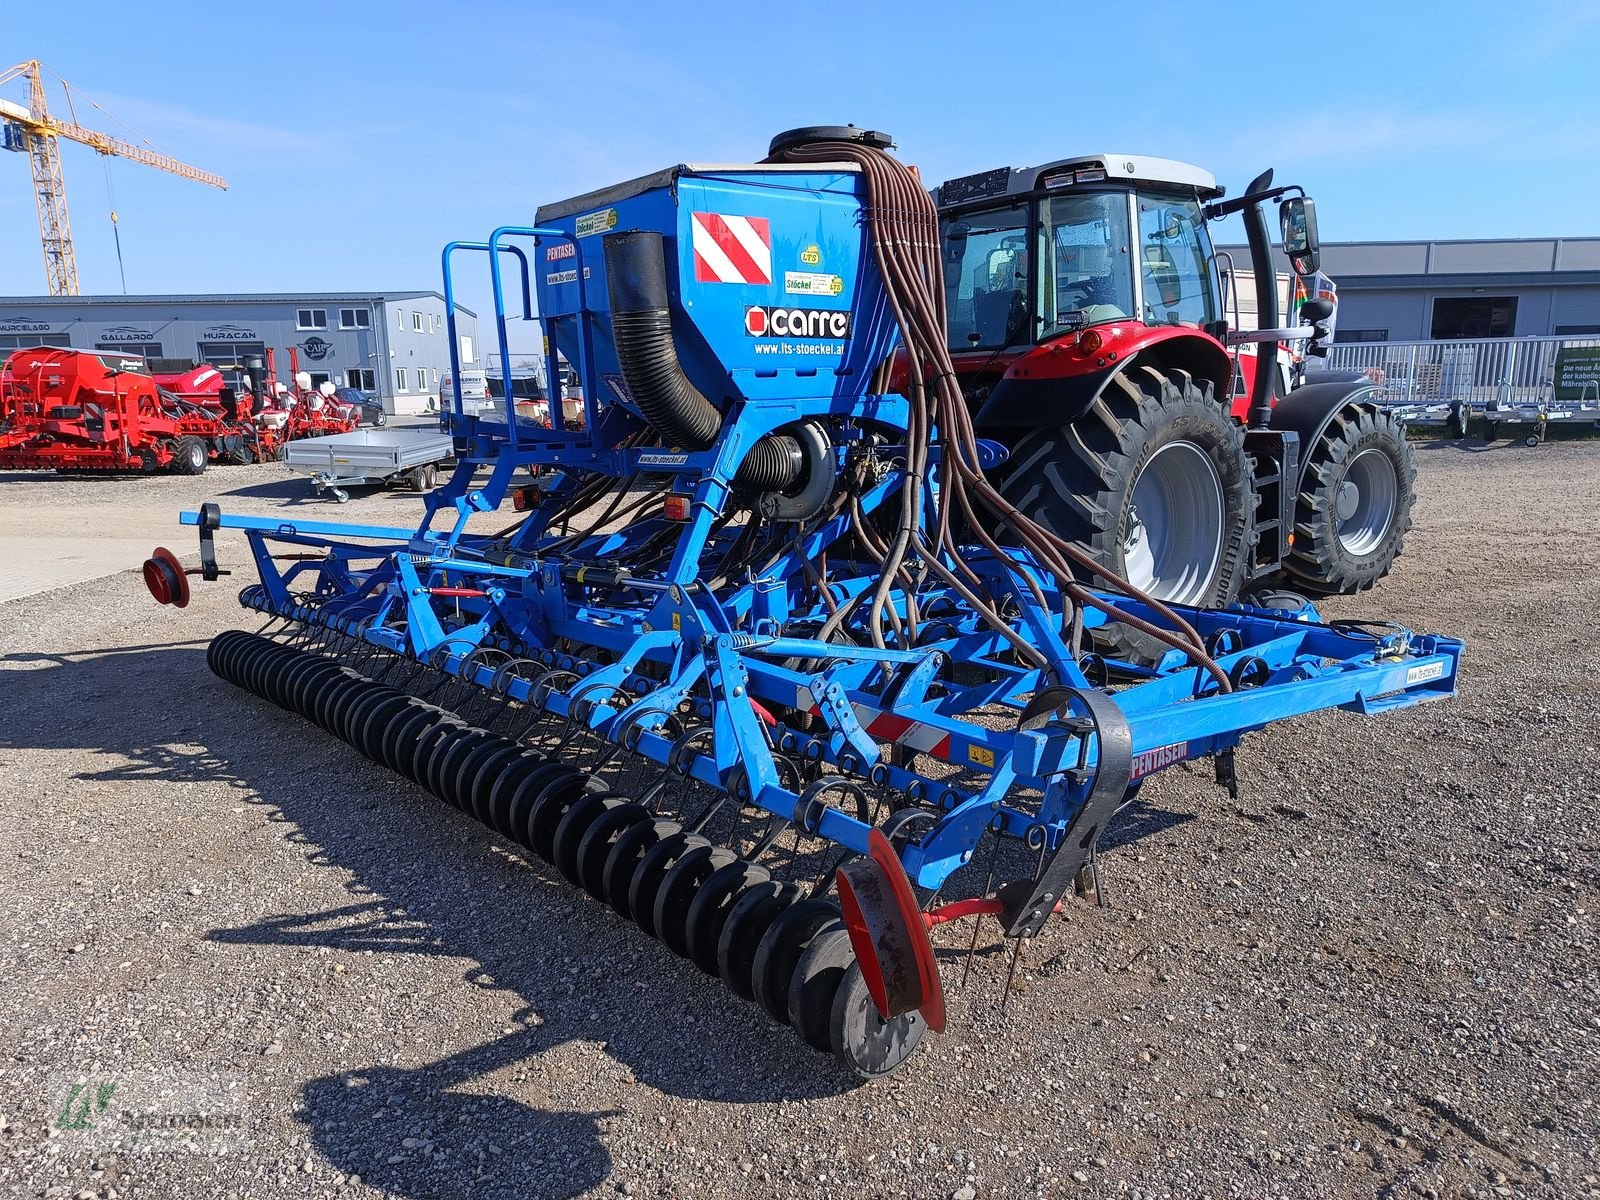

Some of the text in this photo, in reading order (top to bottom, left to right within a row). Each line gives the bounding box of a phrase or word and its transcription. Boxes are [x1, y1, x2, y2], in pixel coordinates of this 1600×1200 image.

[802, 253, 817, 262] LTS
[786, 279, 812, 290] Stöckel
[770, 309, 847, 338] carre
[101, 333, 154, 341] GALLARDO
[754, 342, 845, 355] www.lts-stoeckel.at
[1215, 517, 1247, 609] TRELLEBORG
[1131, 743, 1188, 779] PENTASEM
